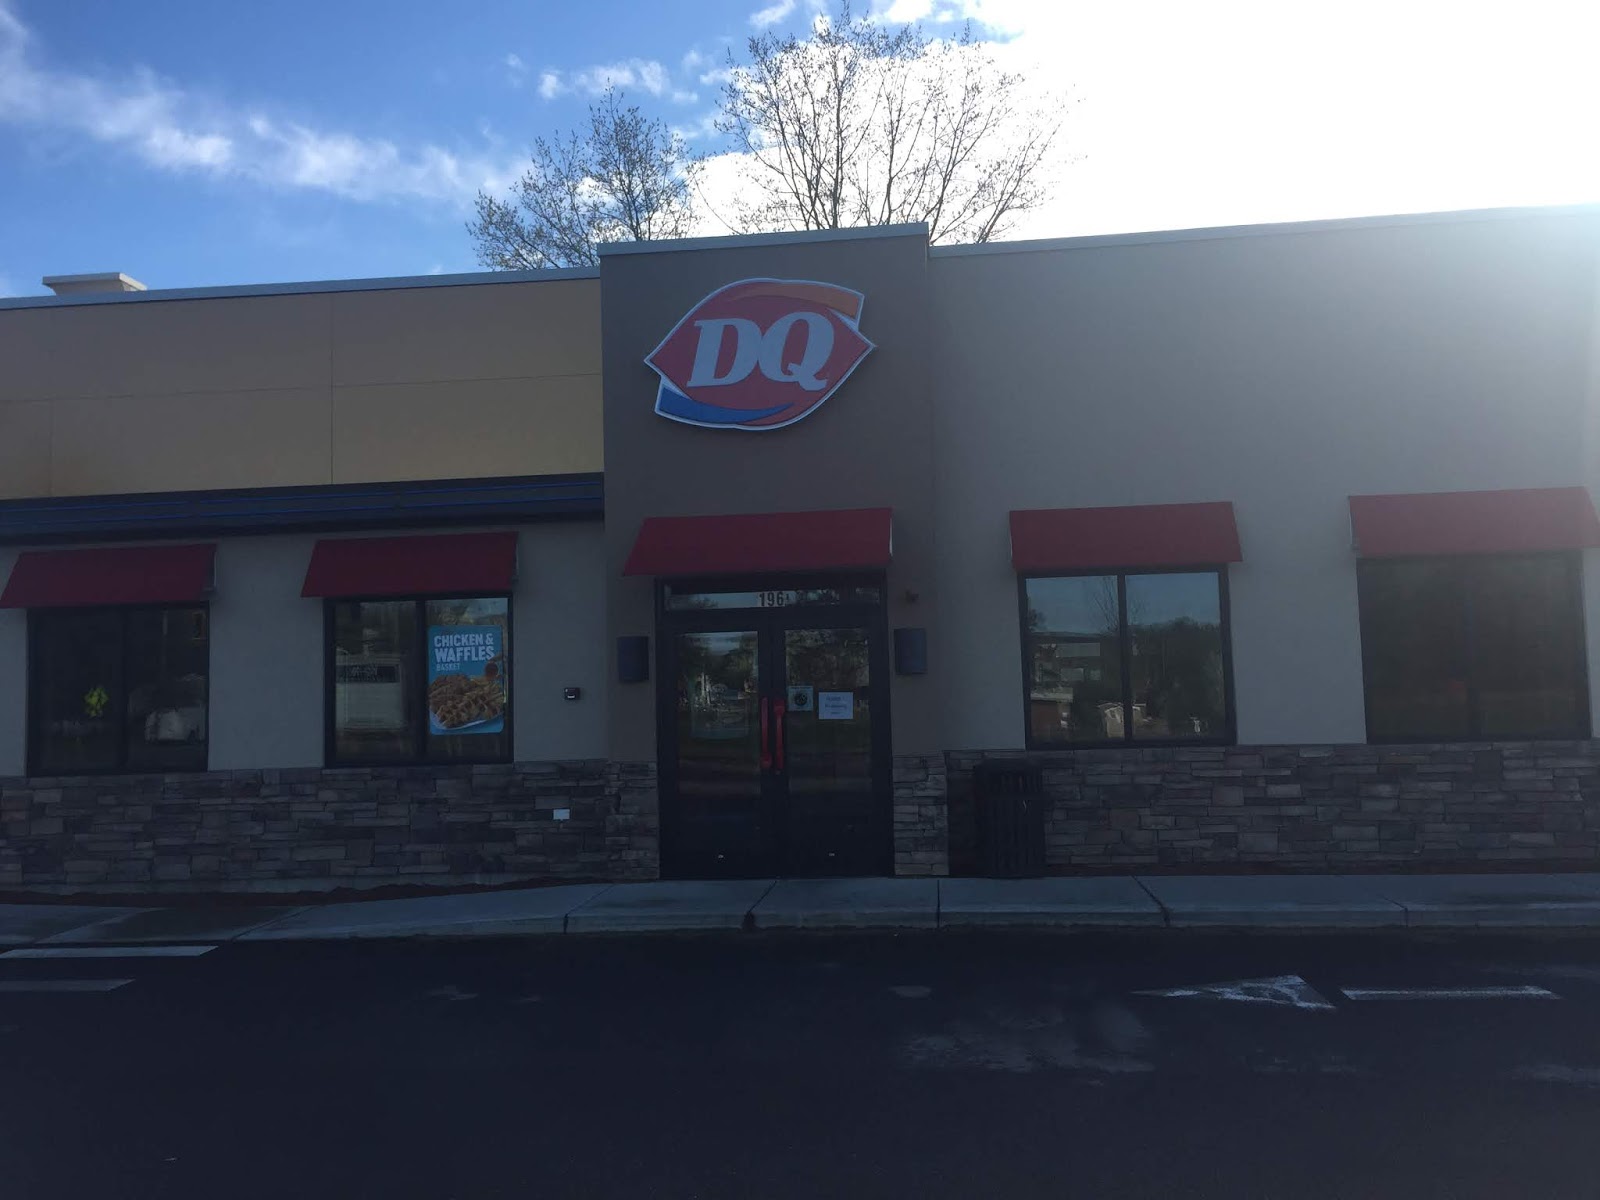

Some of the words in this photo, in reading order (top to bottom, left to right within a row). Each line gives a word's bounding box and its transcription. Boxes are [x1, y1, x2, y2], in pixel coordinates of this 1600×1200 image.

[687, 311, 834, 391] DQ
[434, 633, 484, 647] CHICKEN
[485, 632, 494, 646] &
[434, 646, 495, 663] WAFFLES
[436, 662, 460, 672] BASKET
